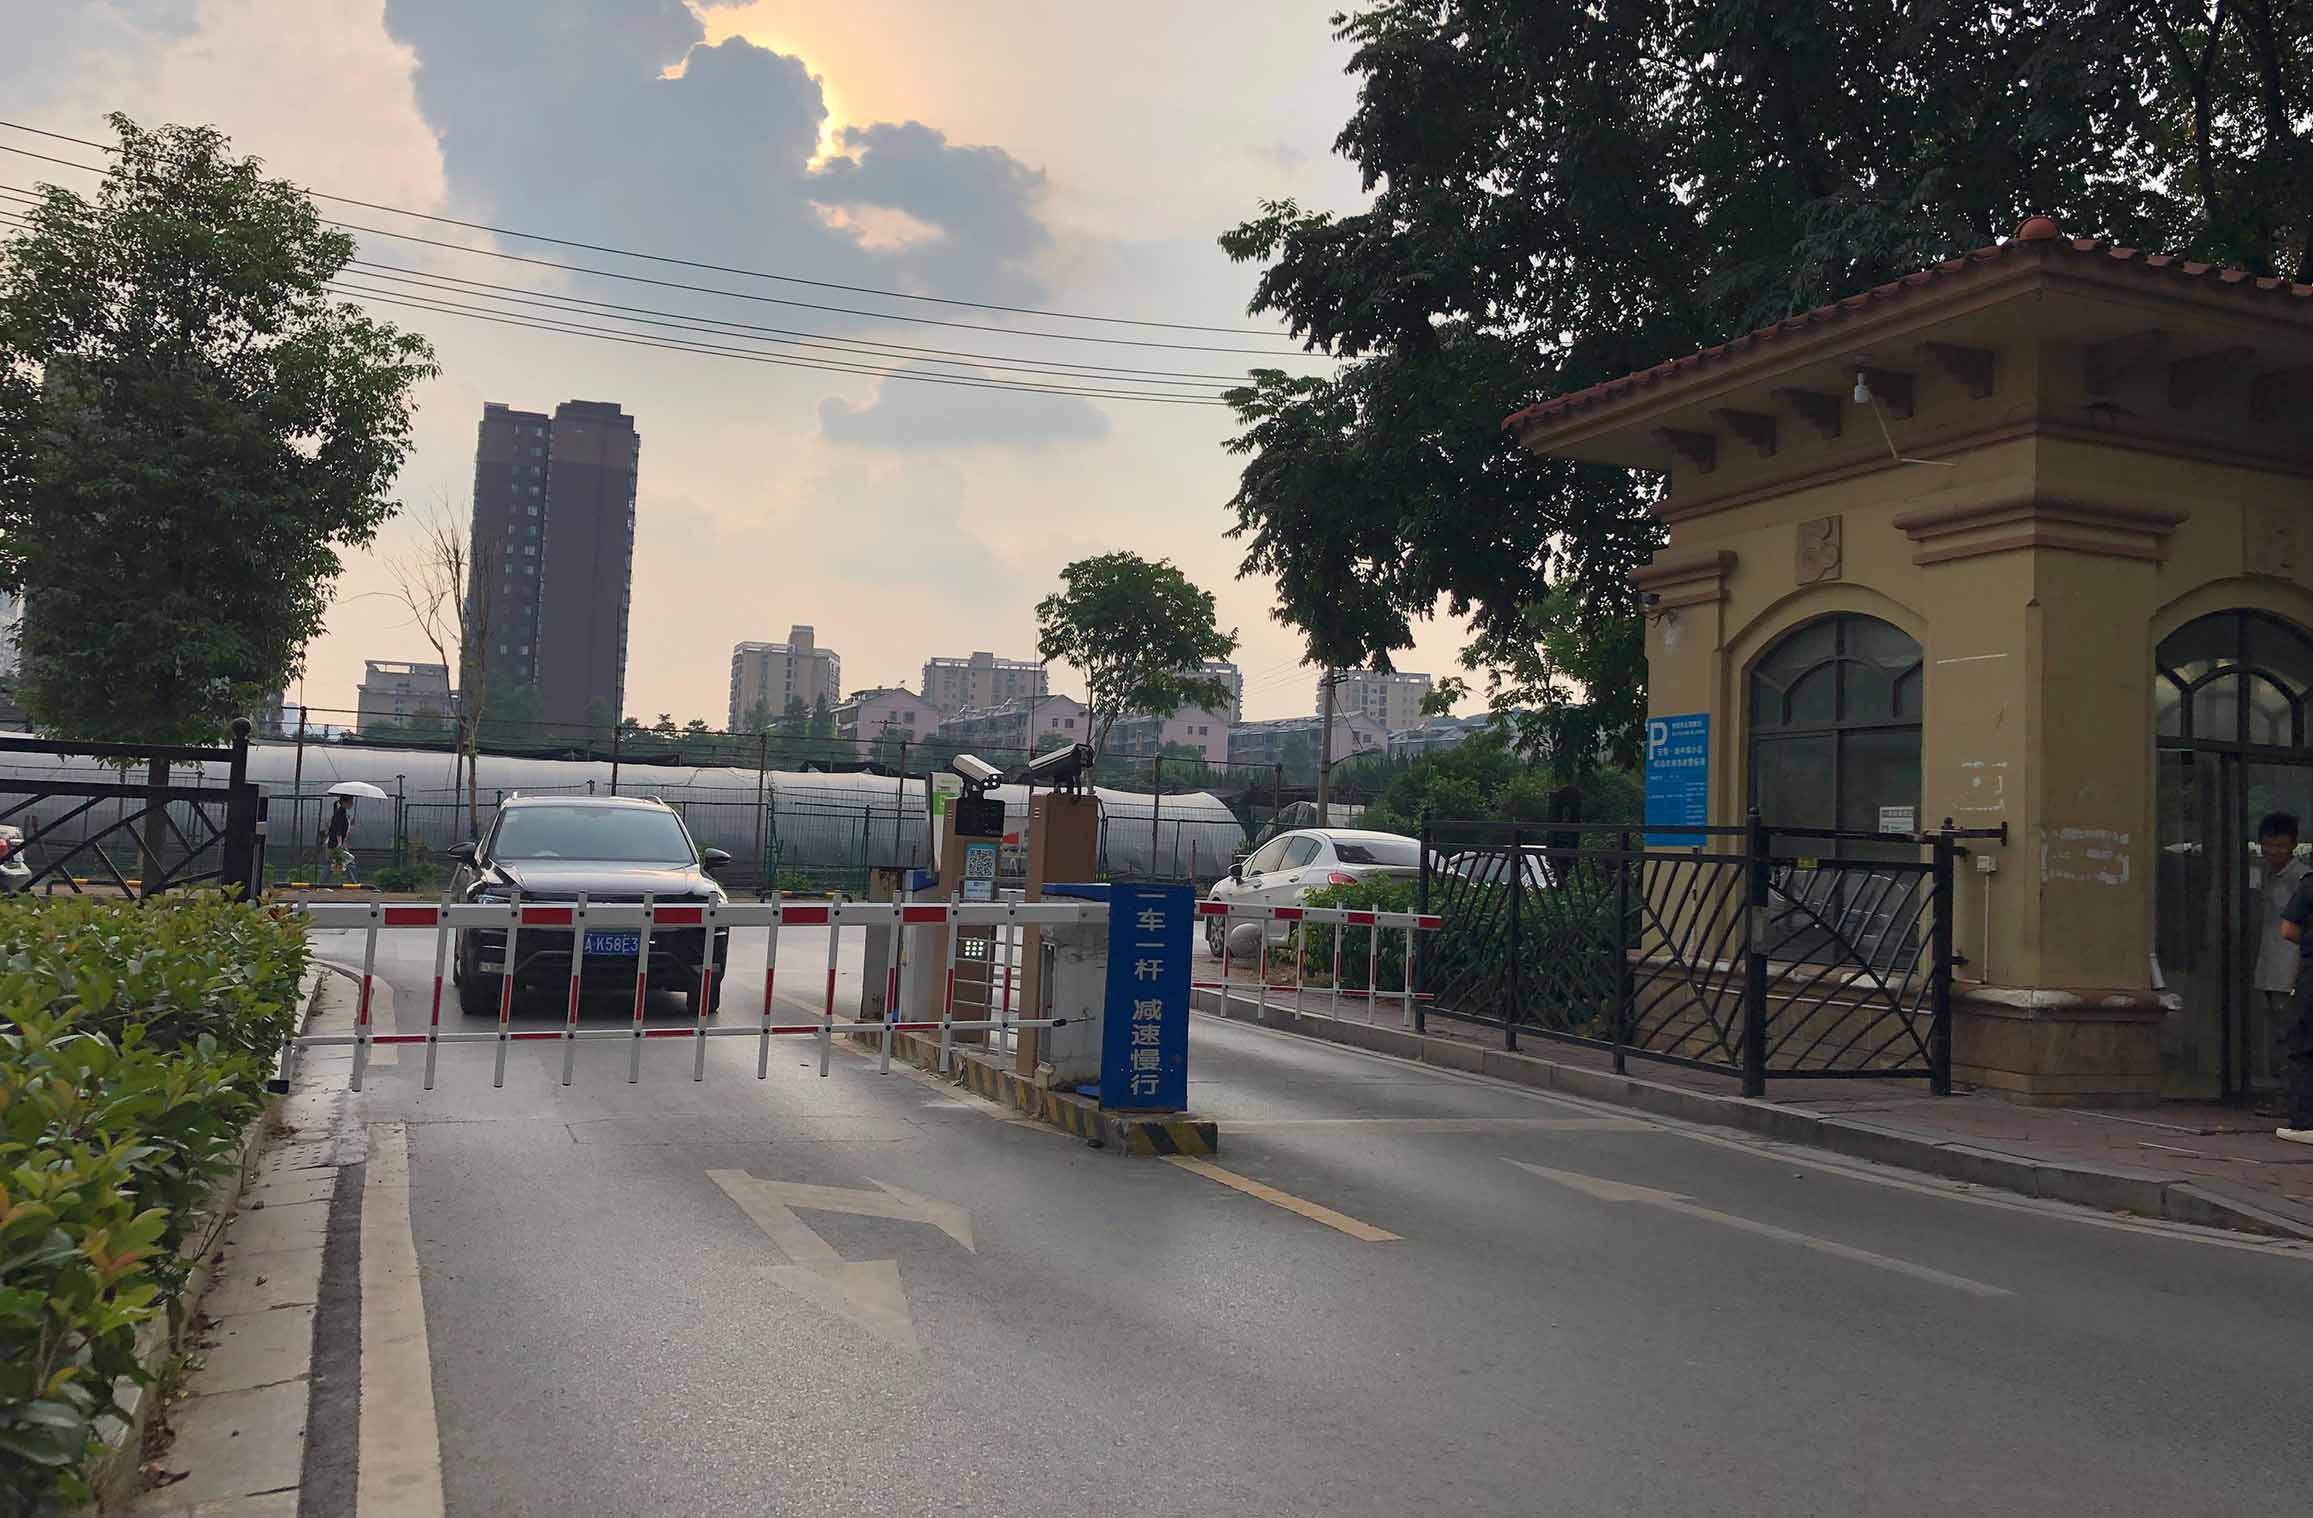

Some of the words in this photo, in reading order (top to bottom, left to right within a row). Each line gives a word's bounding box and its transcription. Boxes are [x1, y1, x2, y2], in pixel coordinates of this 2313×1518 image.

[1648, 722, 1668, 761] P
[1134, 893, 1168, 982] 一车一杆
[1130, 998, 1163, 1096] 减速慢行
